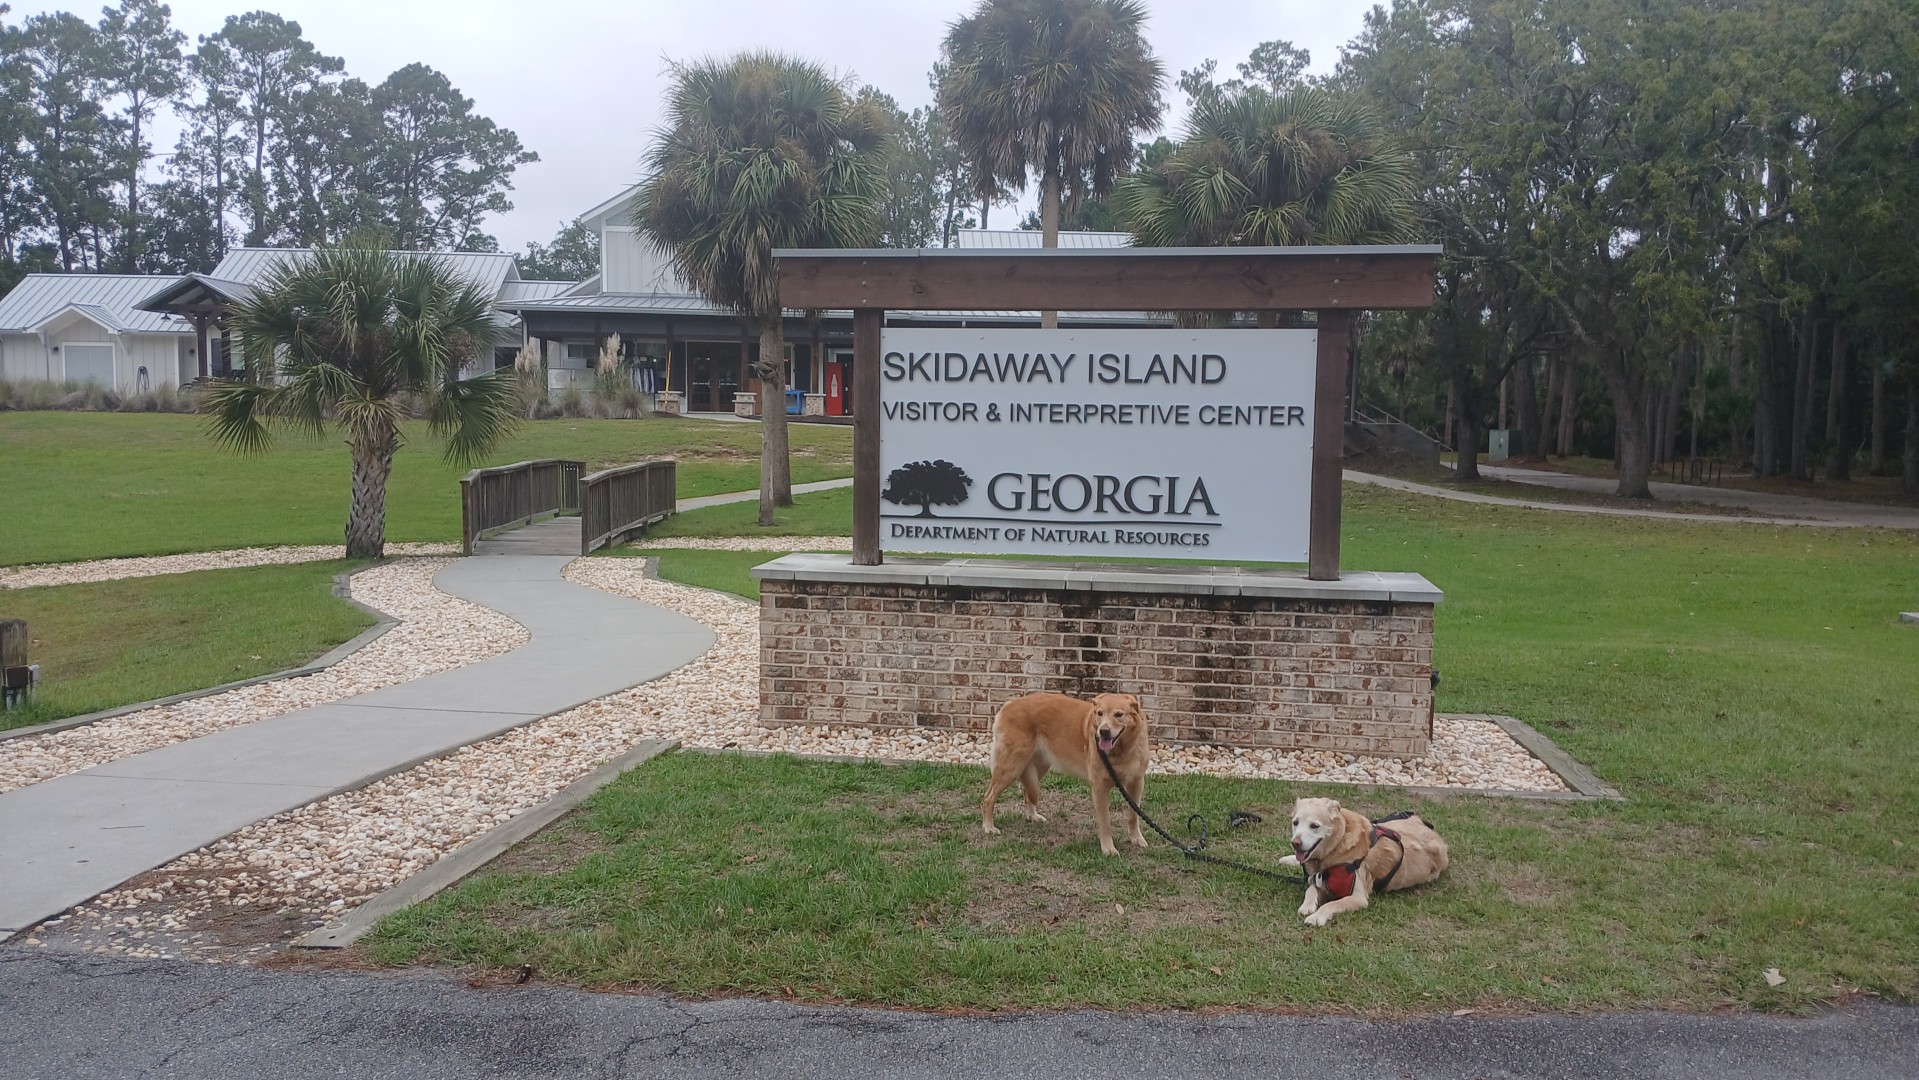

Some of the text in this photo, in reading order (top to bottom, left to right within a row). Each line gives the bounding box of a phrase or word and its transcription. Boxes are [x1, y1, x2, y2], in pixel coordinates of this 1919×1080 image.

[882, 351, 1227, 386] SKIDAWAY ISLAND
[881, 400, 1305, 428] VISITOR & INTERPRETIVE CENTER
[986, 471, 1221, 517] GEORGIA
[890, 522, 1210, 547] DEPARTMENT OF NATURAL RESOURCES
